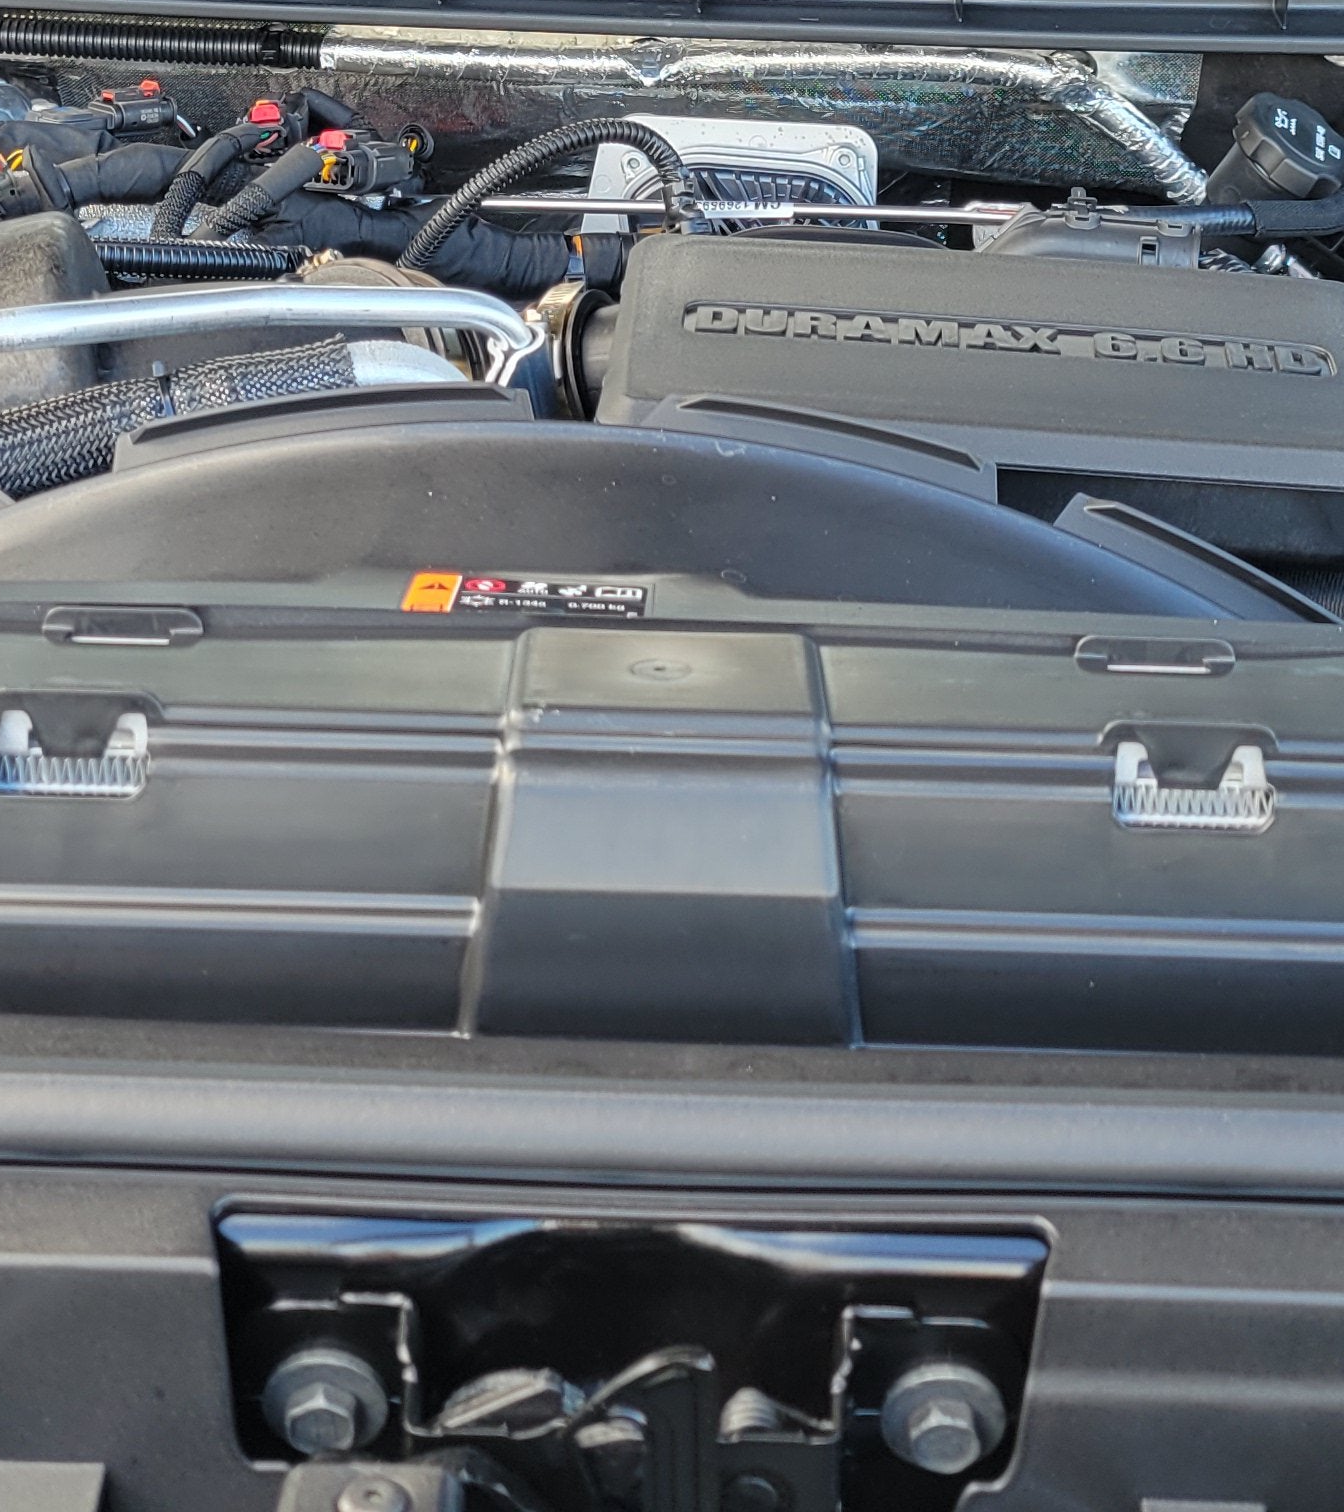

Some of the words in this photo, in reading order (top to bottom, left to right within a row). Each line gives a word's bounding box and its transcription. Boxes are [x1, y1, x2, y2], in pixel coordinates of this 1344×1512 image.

[694, 305, 1061, 355] DURAMAX
[1093, 332, 1206, 366] 6.6
[1224, 341, 1323, 376] HD
